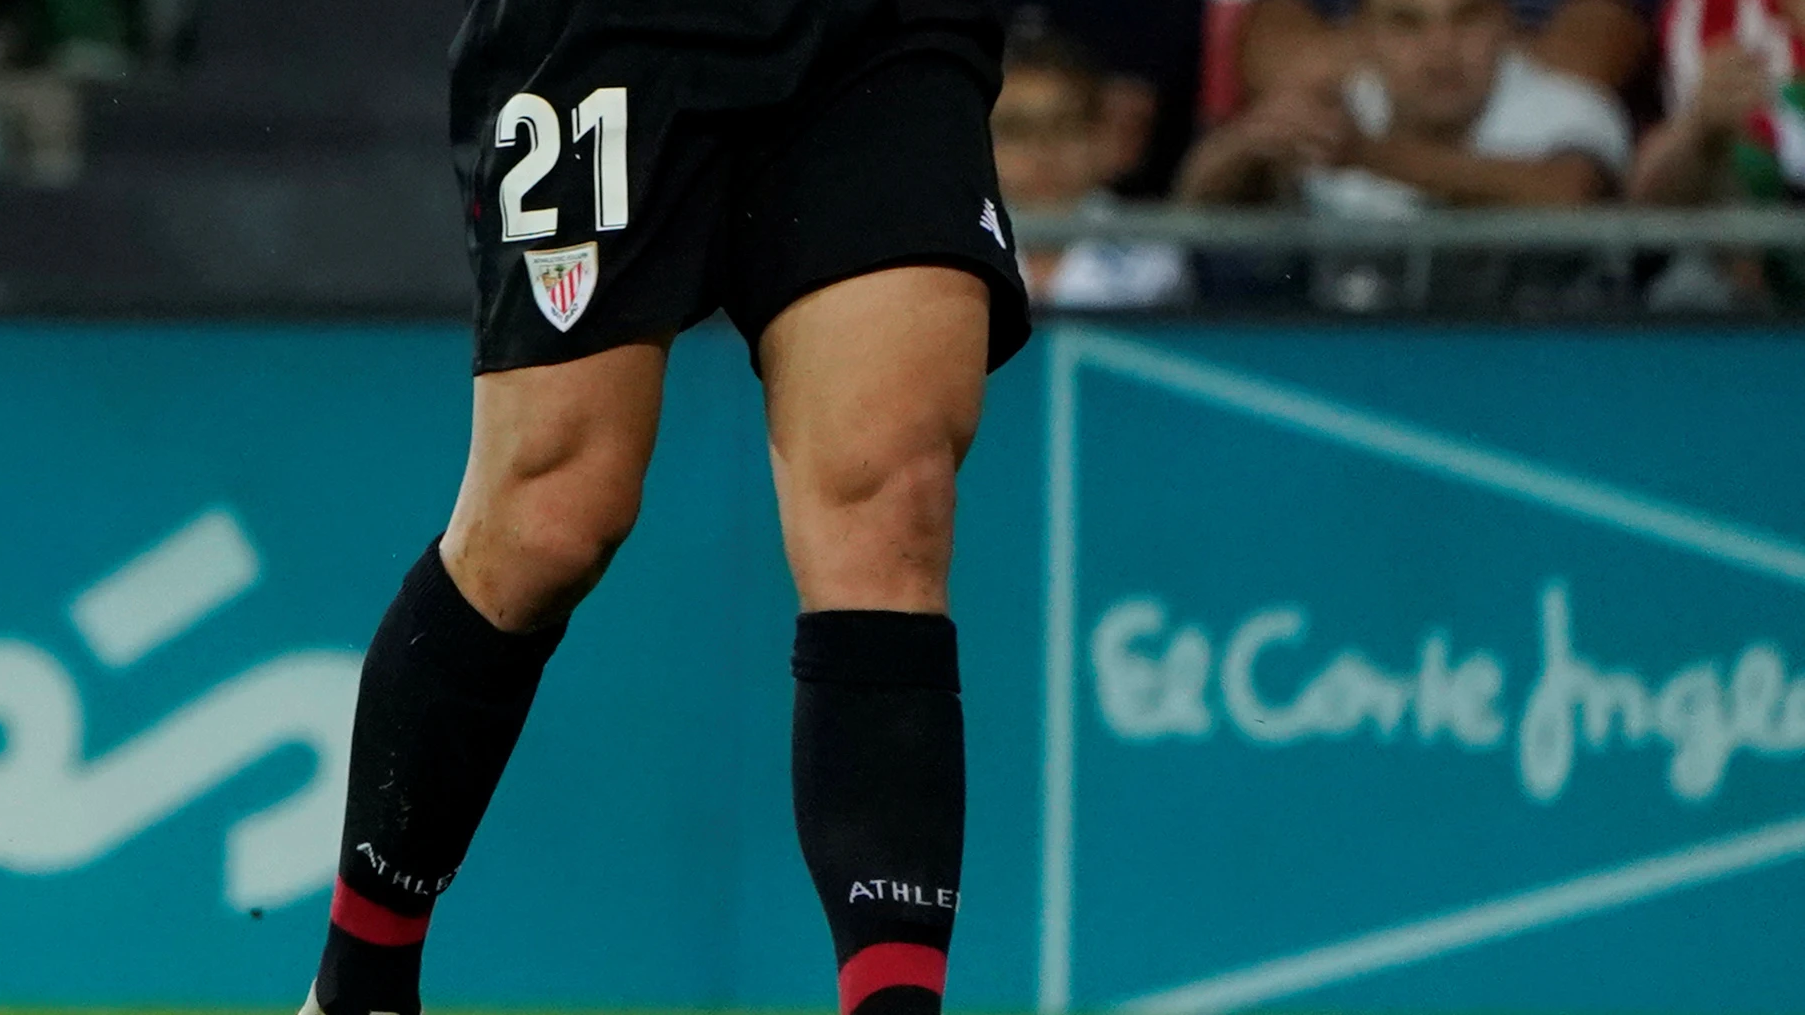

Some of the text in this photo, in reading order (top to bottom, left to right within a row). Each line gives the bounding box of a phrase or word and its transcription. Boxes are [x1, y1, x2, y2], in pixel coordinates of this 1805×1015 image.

[495, 87, 628, 242] 21
[1091, 576, 1805, 802] El Corte Ingl
[849, 879, 961, 914] ATHLE
